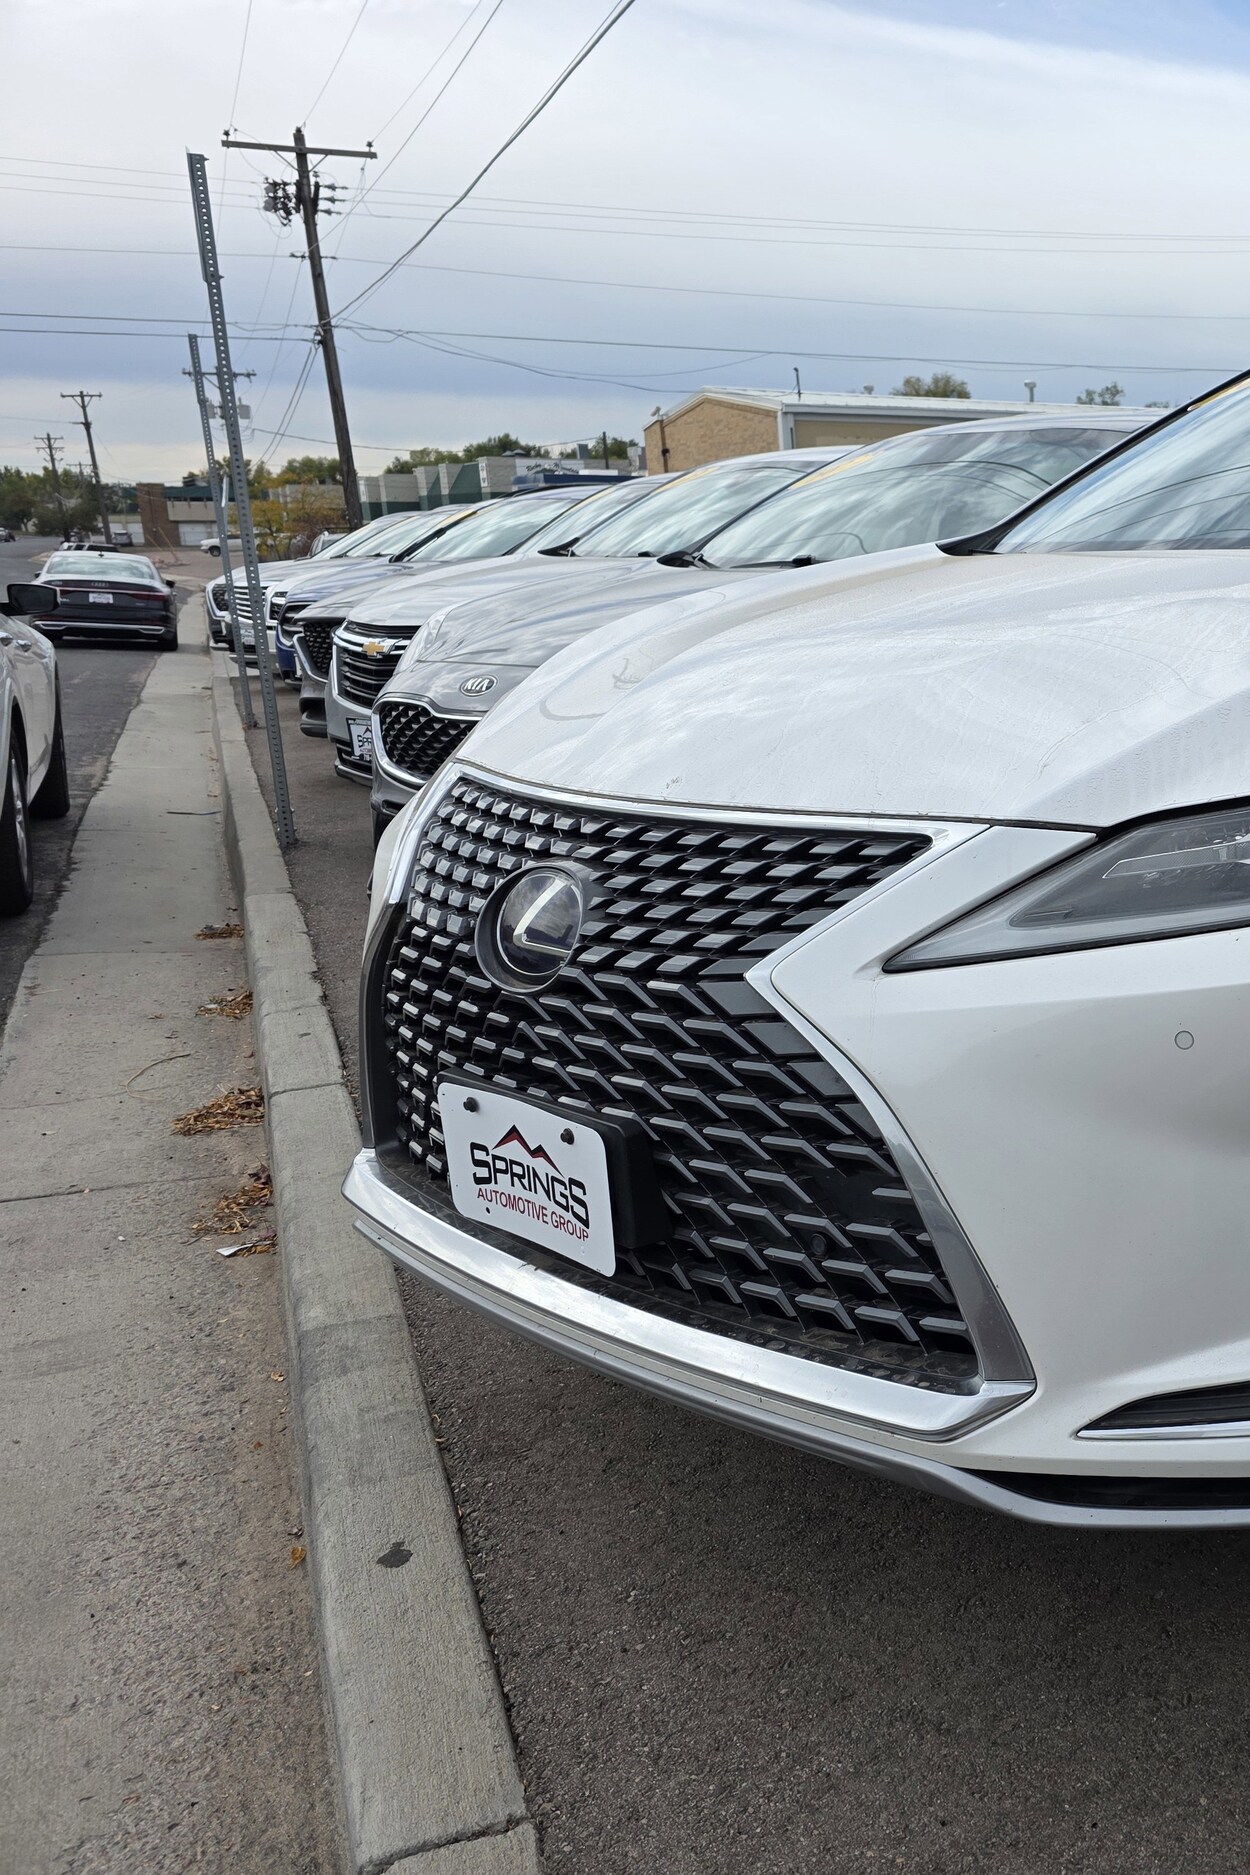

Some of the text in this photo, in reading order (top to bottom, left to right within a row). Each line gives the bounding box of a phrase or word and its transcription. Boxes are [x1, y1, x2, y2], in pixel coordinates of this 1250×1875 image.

[464, 678, 490, 691] KIA
[470, 1142, 589, 1229] SPRINGS
[477, 1187, 589, 1242] AUTOMOTIVE GROUP
